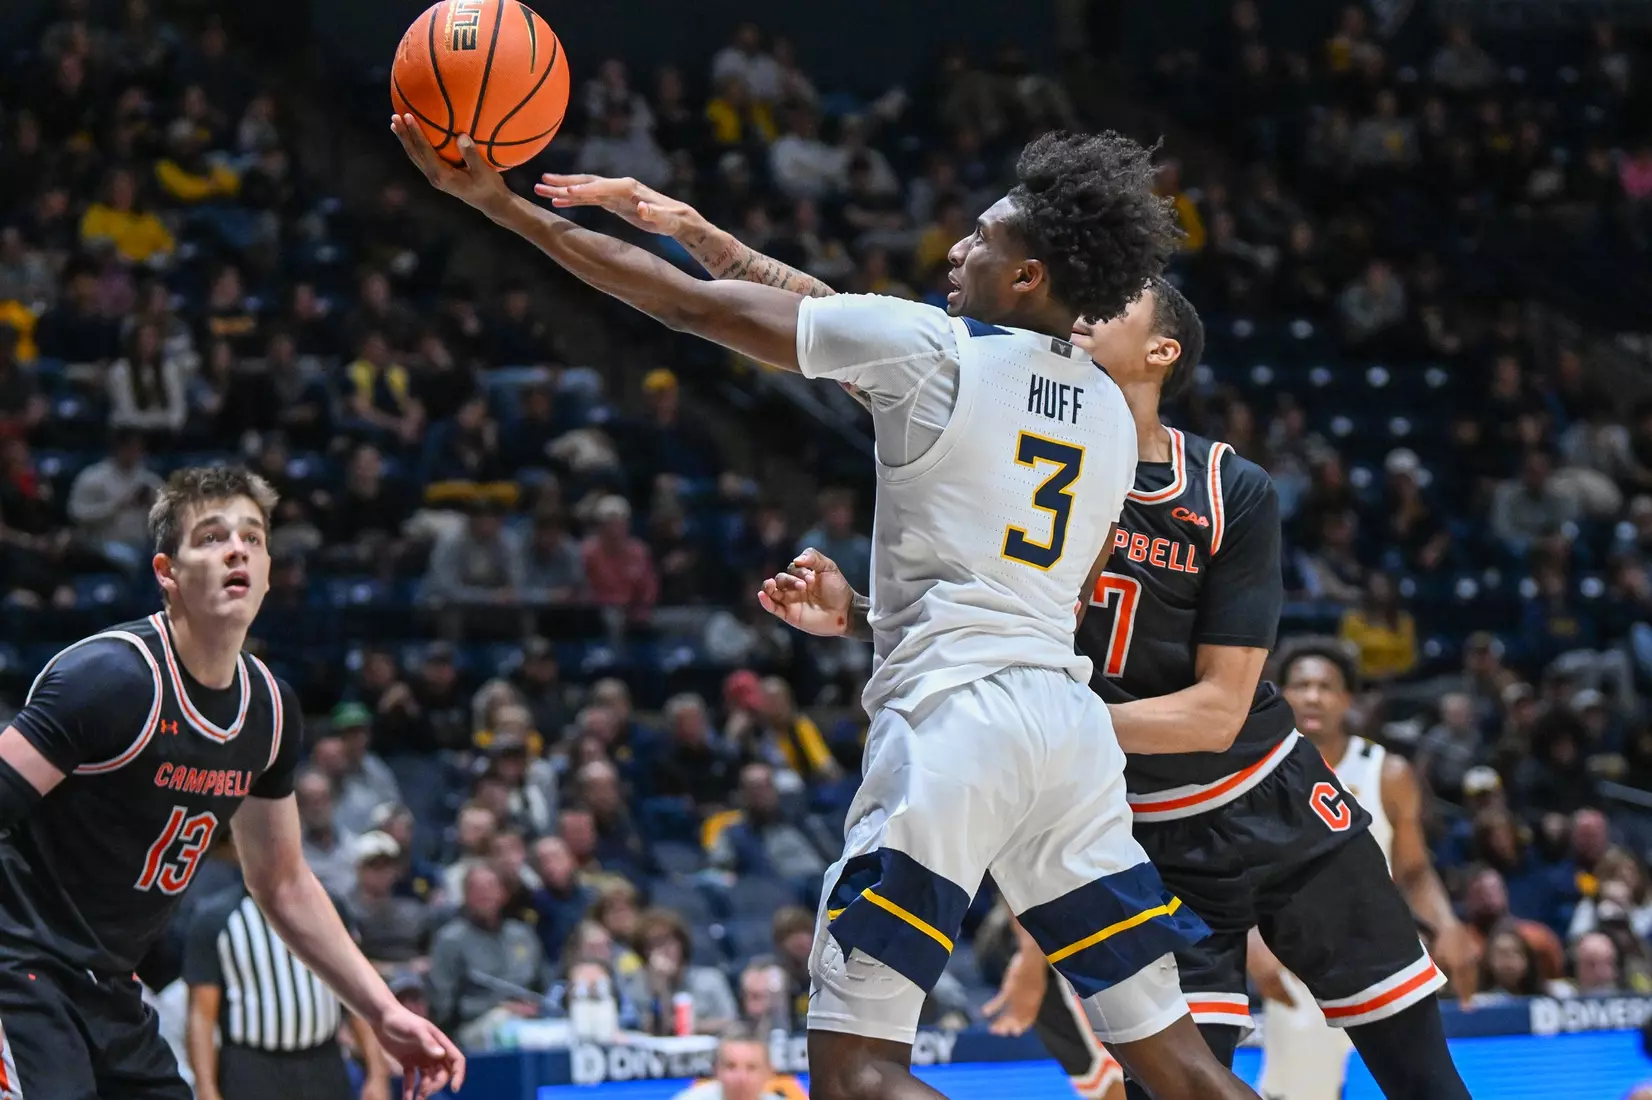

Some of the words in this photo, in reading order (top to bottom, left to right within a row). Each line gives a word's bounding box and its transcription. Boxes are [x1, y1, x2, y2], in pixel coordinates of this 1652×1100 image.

[1027, 373, 1084, 424] HUFF
[1001, 430, 1086, 571] 3
[1171, 506, 1210, 527] CAA
[1111, 528, 1199, 573] PBELL
[1089, 571, 1142, 678] 7
[154, 762, 252, 797] CAMPBELL
[1309, 782, 1351, 831] C
[134, 805, 219, 895] 13
